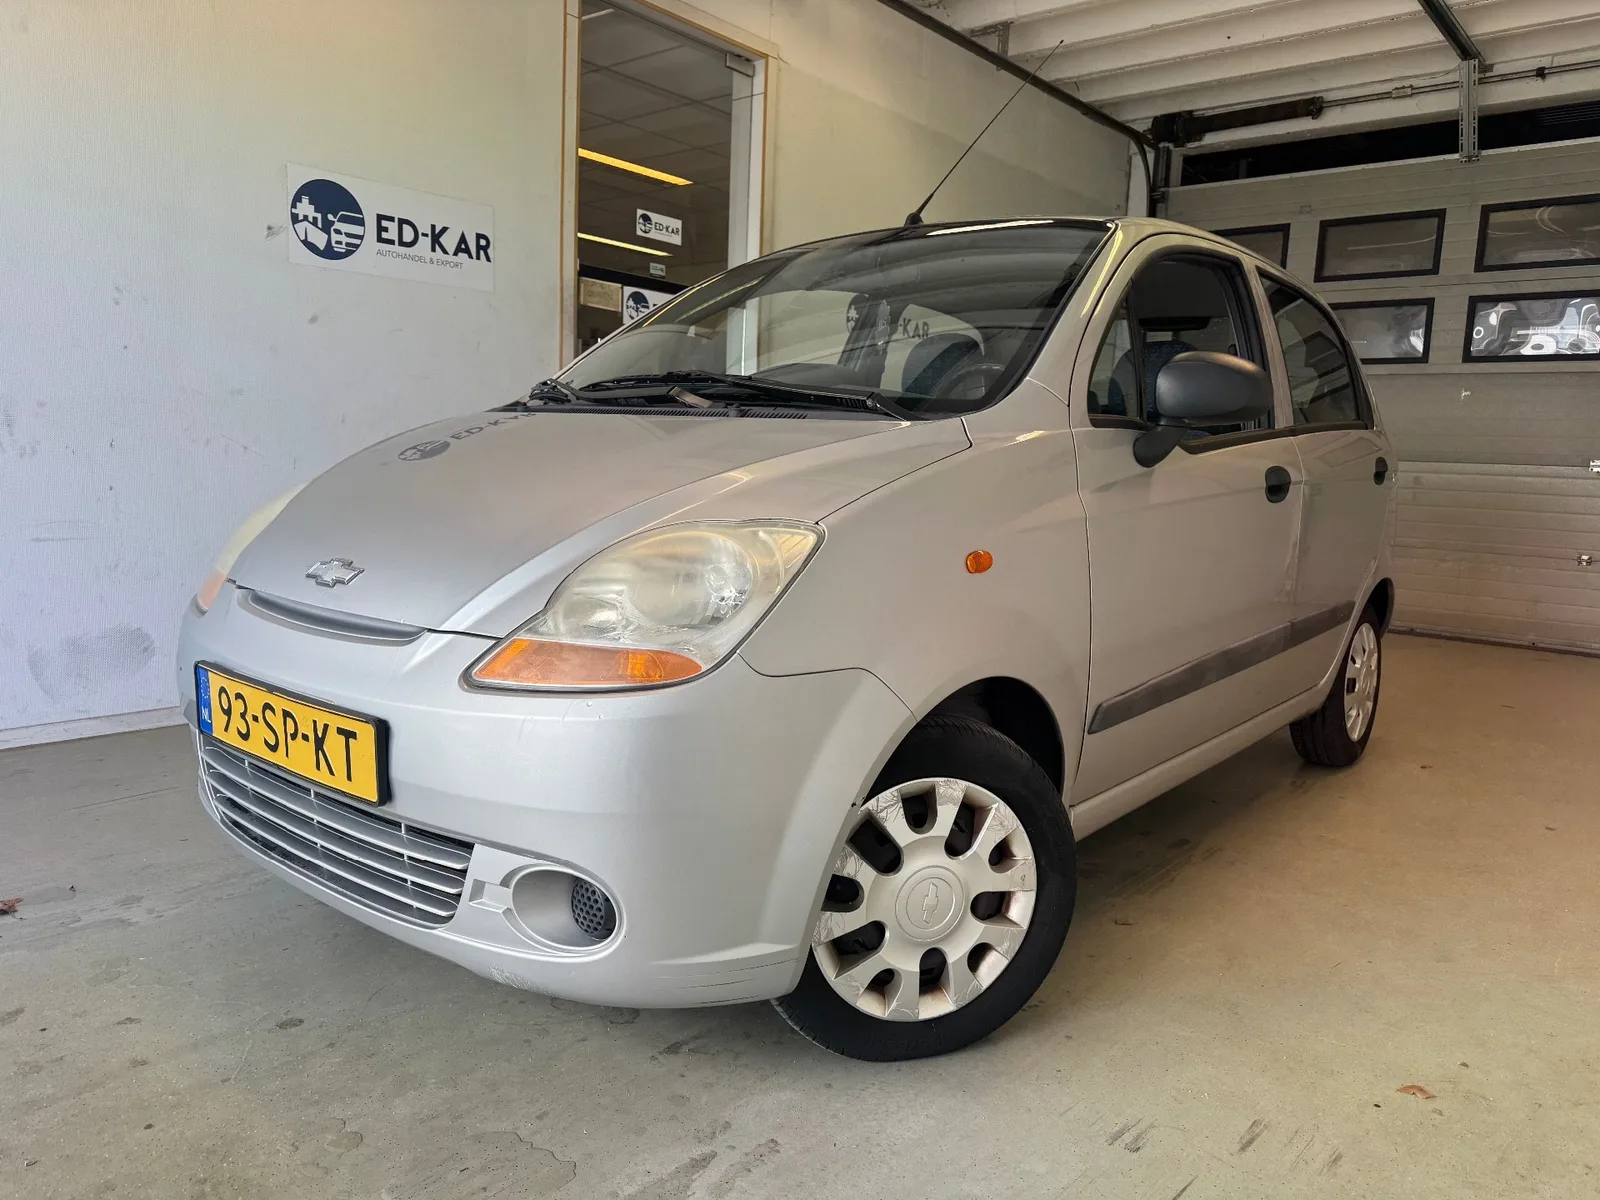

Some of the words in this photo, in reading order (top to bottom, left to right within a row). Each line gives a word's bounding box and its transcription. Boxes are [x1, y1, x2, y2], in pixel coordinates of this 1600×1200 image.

[376, 213, 492, 263] ED-KAR
[654, 221, 680, 236] ED-KAR
[376, 249, 428, 264] AUTOHANDEL
[436, 259, 463, 270] EXPORT
[200, 705, 212, 723] NL
[218, 685, 358, 782] 93-SP-KT
